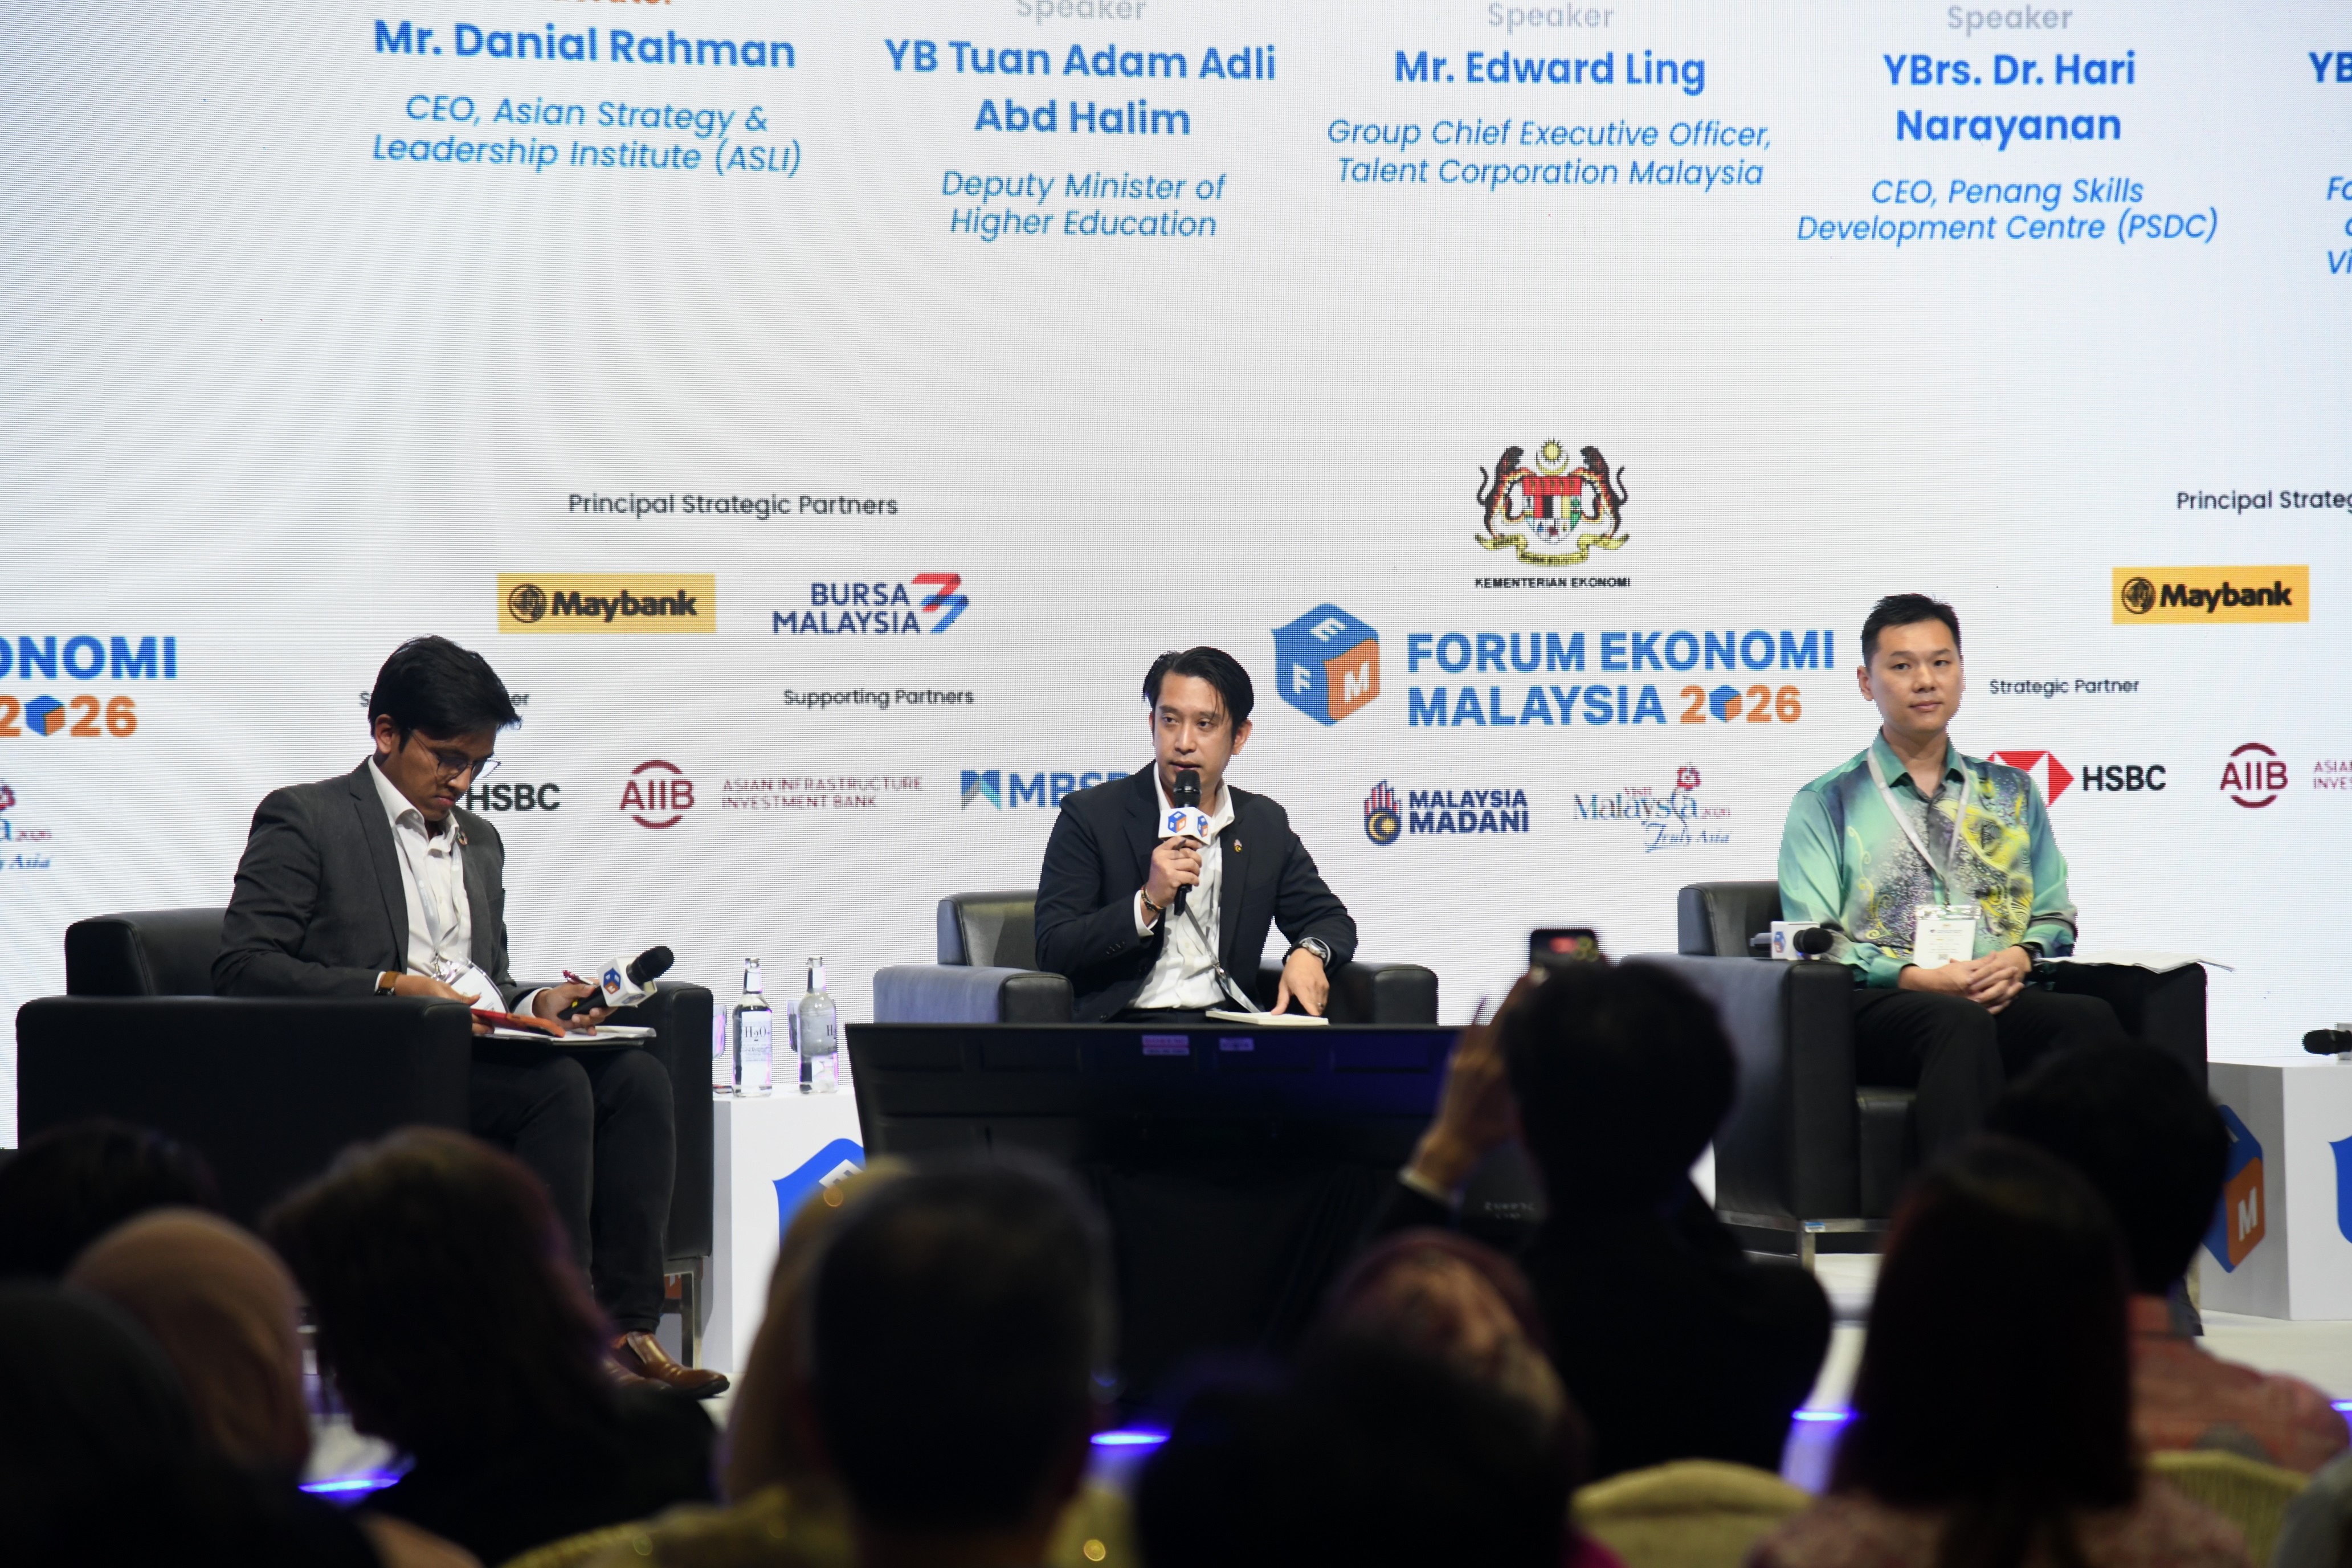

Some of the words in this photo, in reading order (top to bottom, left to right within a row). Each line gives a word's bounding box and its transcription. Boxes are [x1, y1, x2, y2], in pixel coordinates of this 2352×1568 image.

[1016, 0, 1146, 24] Speaker
[1487, 2, 1615, 34] Speaker
[1947, 5, 2073, 36] Speaker
[374, 19, 443, 56] Mr.
[456, 22, 598, 62] Danial
[611, 29, 795, 68] Rahman
[885, 39, 938, 72] YB
[949, 40, 1051, 75] Tuan
[1063, 43, 1187, 78] Adam
[1198, 44, 1276, 80] Adli
[1396, 50, 1455, 83] Mr.
[1467, 50, 1614, 85] Edward
[1627, 50, 1705, 96] Ling
[1884, 54, 1982, 85] YBrs.
[1994, 55, 2044, 85] Dr.
[2055, 50, 2135, 85] Hari
[406, 95, 481, 126] CEO,
[494, 97, 586, 126] Asian
[597, 101, 734, 139] Strategy
[745, 107, 768, 132] &
[974, 99, 1057, 132] Abd
[1069, 99, 1191, 135] Halim
[1896, 109, 2122, 152] Narayanan
[1328, 119, 1421, 152] Group
[1431, 119, 1512, 145] Chief
[1520, 120, 1659, 147] Executive
[1669, 120, 1772, 150] Officer,
[373, 134, 558, 173] Leadership
[570, 141, 701, 169] Institute
[716, 138, 801, 177] (ASLI)
[942, 171, 1055, 205] Deputy
[1065, 172, 1186, 199] Minister
[1196, 173, 1226, 201] of
[1339, 157, 1429, 183] Talent
[1439, 158, 1618, 192] Corporation
[1629, 159, 1765, 194] Malaysia
[1872, 179, 1937, 209] CEO,
[1949, 179, 2061, 211] Penang
[2072, 178, 2144, 205] Skills
[950, 207, 1054, 243] Higher
[1064, 209, 1217, 237] Education
[1797, 215, 1996, 247] Development
[2006, 215, 2105, 240] Centre
[2118, 207, 2218, 244] (PSDC)
[569, 492, 675, 519] Principal
[683, 493, 791, 520] Strategic
[799, 495, 899, 514] Partners
[2178, 491, 2272, 514] Principal
[811, 583, 910, 606] BURSA
[1476, 578, 1567, 588] KEMENTERIAN
[1572, 577, 1630, 587] EKONOMI
[2159, 581, 2292, 613] Maybank
[551, 589, 697, 623] Maybank
[773, 610, 921, 634] MALAYSIA
[1407, 632, 1586, 673] FORUM
[1600, 630, 1835, 671] EKONOMI
[784, 688, 889, 709] Supporting
[895, 689, 974, 705] Partners
[1990, 679, 2069, 699] Strategic
[2075, 679, 2139, 693] Partner
[1408, 684, 1667, 727] MALAYSIA
[722, 778, 773, 793] ASIAN
[778, 777, 923, 791] INFRASTRUCTURE
[2082, 765, 2166, 791] HSBC
[2220, 761, 2288, 790] AIIB
[465, 783, 560, 811] HSBC
[619, 779, 695, 810] AIIB
[722, 795, 828, 809] INVESTMENT
[834, 795, 876, 808] BANK
[1409, 789, 1528, 808] MALAYSIA
[1410, 810, 1529, 834] MADANI
